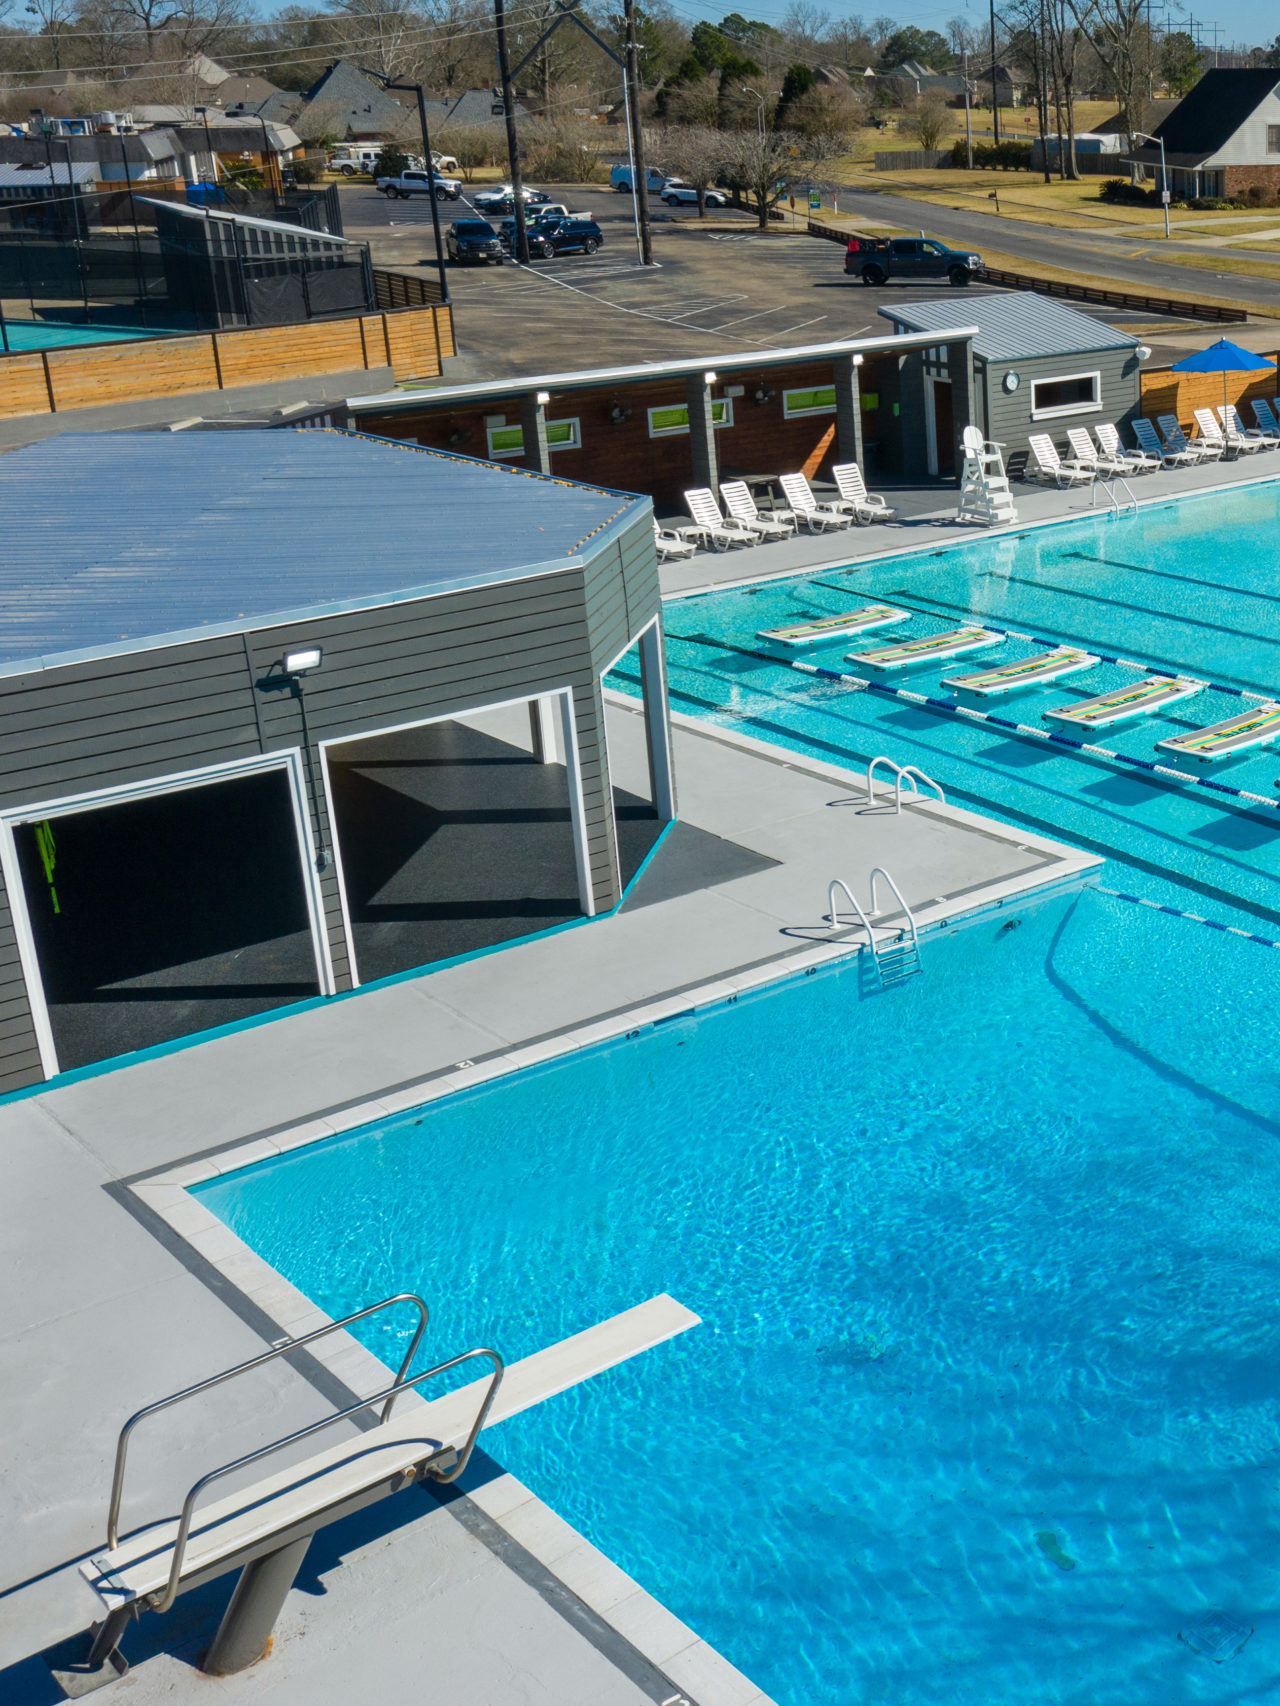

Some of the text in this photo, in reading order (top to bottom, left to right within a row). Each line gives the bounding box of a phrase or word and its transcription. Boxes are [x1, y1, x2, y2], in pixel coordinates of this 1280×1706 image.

[805, 967, 816, 976] 10
[625, 1030, 641, 1040] 12
[455, 1060, 475, 1069] 12
